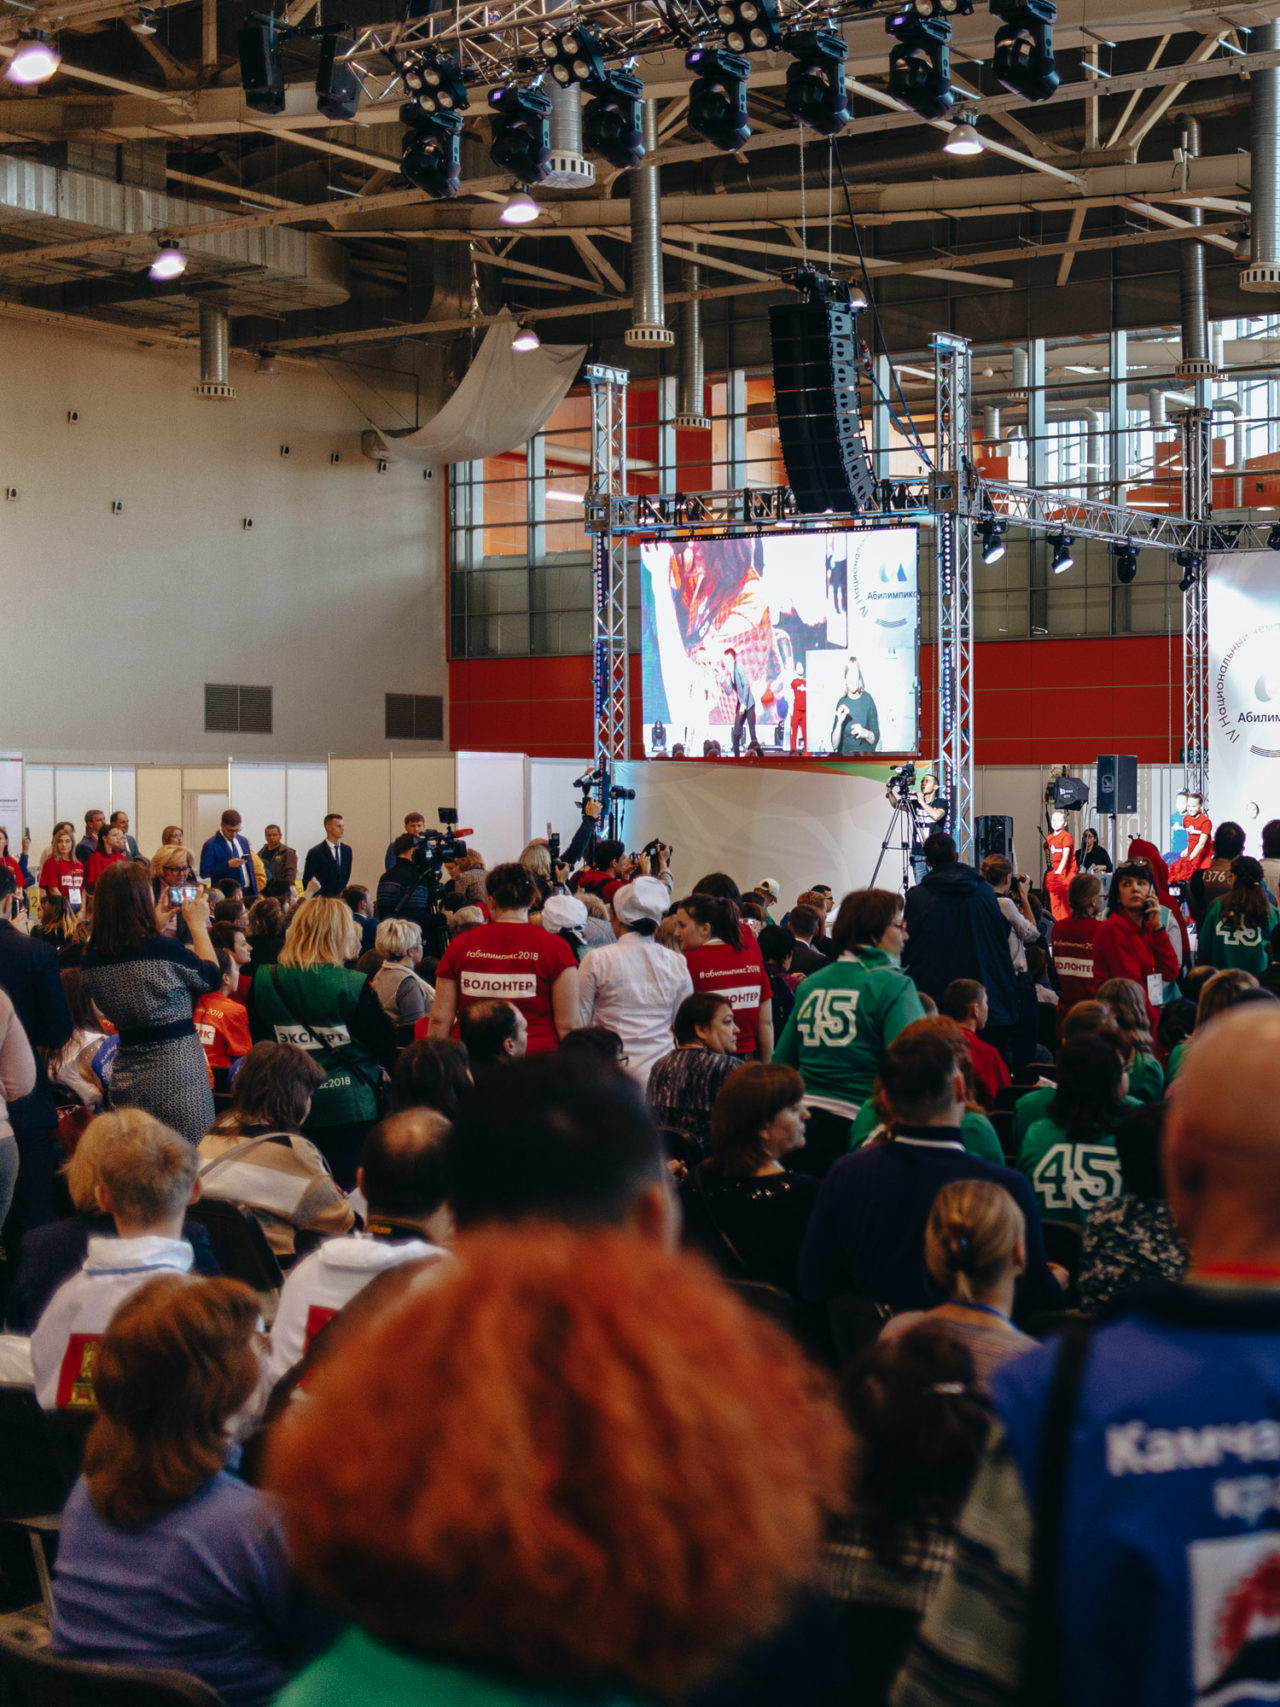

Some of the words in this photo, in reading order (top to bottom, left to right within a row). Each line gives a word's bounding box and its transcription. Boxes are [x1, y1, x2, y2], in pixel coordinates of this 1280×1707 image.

[1225, 728, 1240, 744] IV
[1056, 962, 1092, 972] ОЛОНТЕ
[463, 979, 534, 991] ВОЛОНТЕР
[729, 992, 759, 1003] ОНТЕР
[797, 988, 860, 1046] 45
[280, 1031, 344, 1044] ЭКСРТ
[1033, 1143, 1122, 1210] 45
